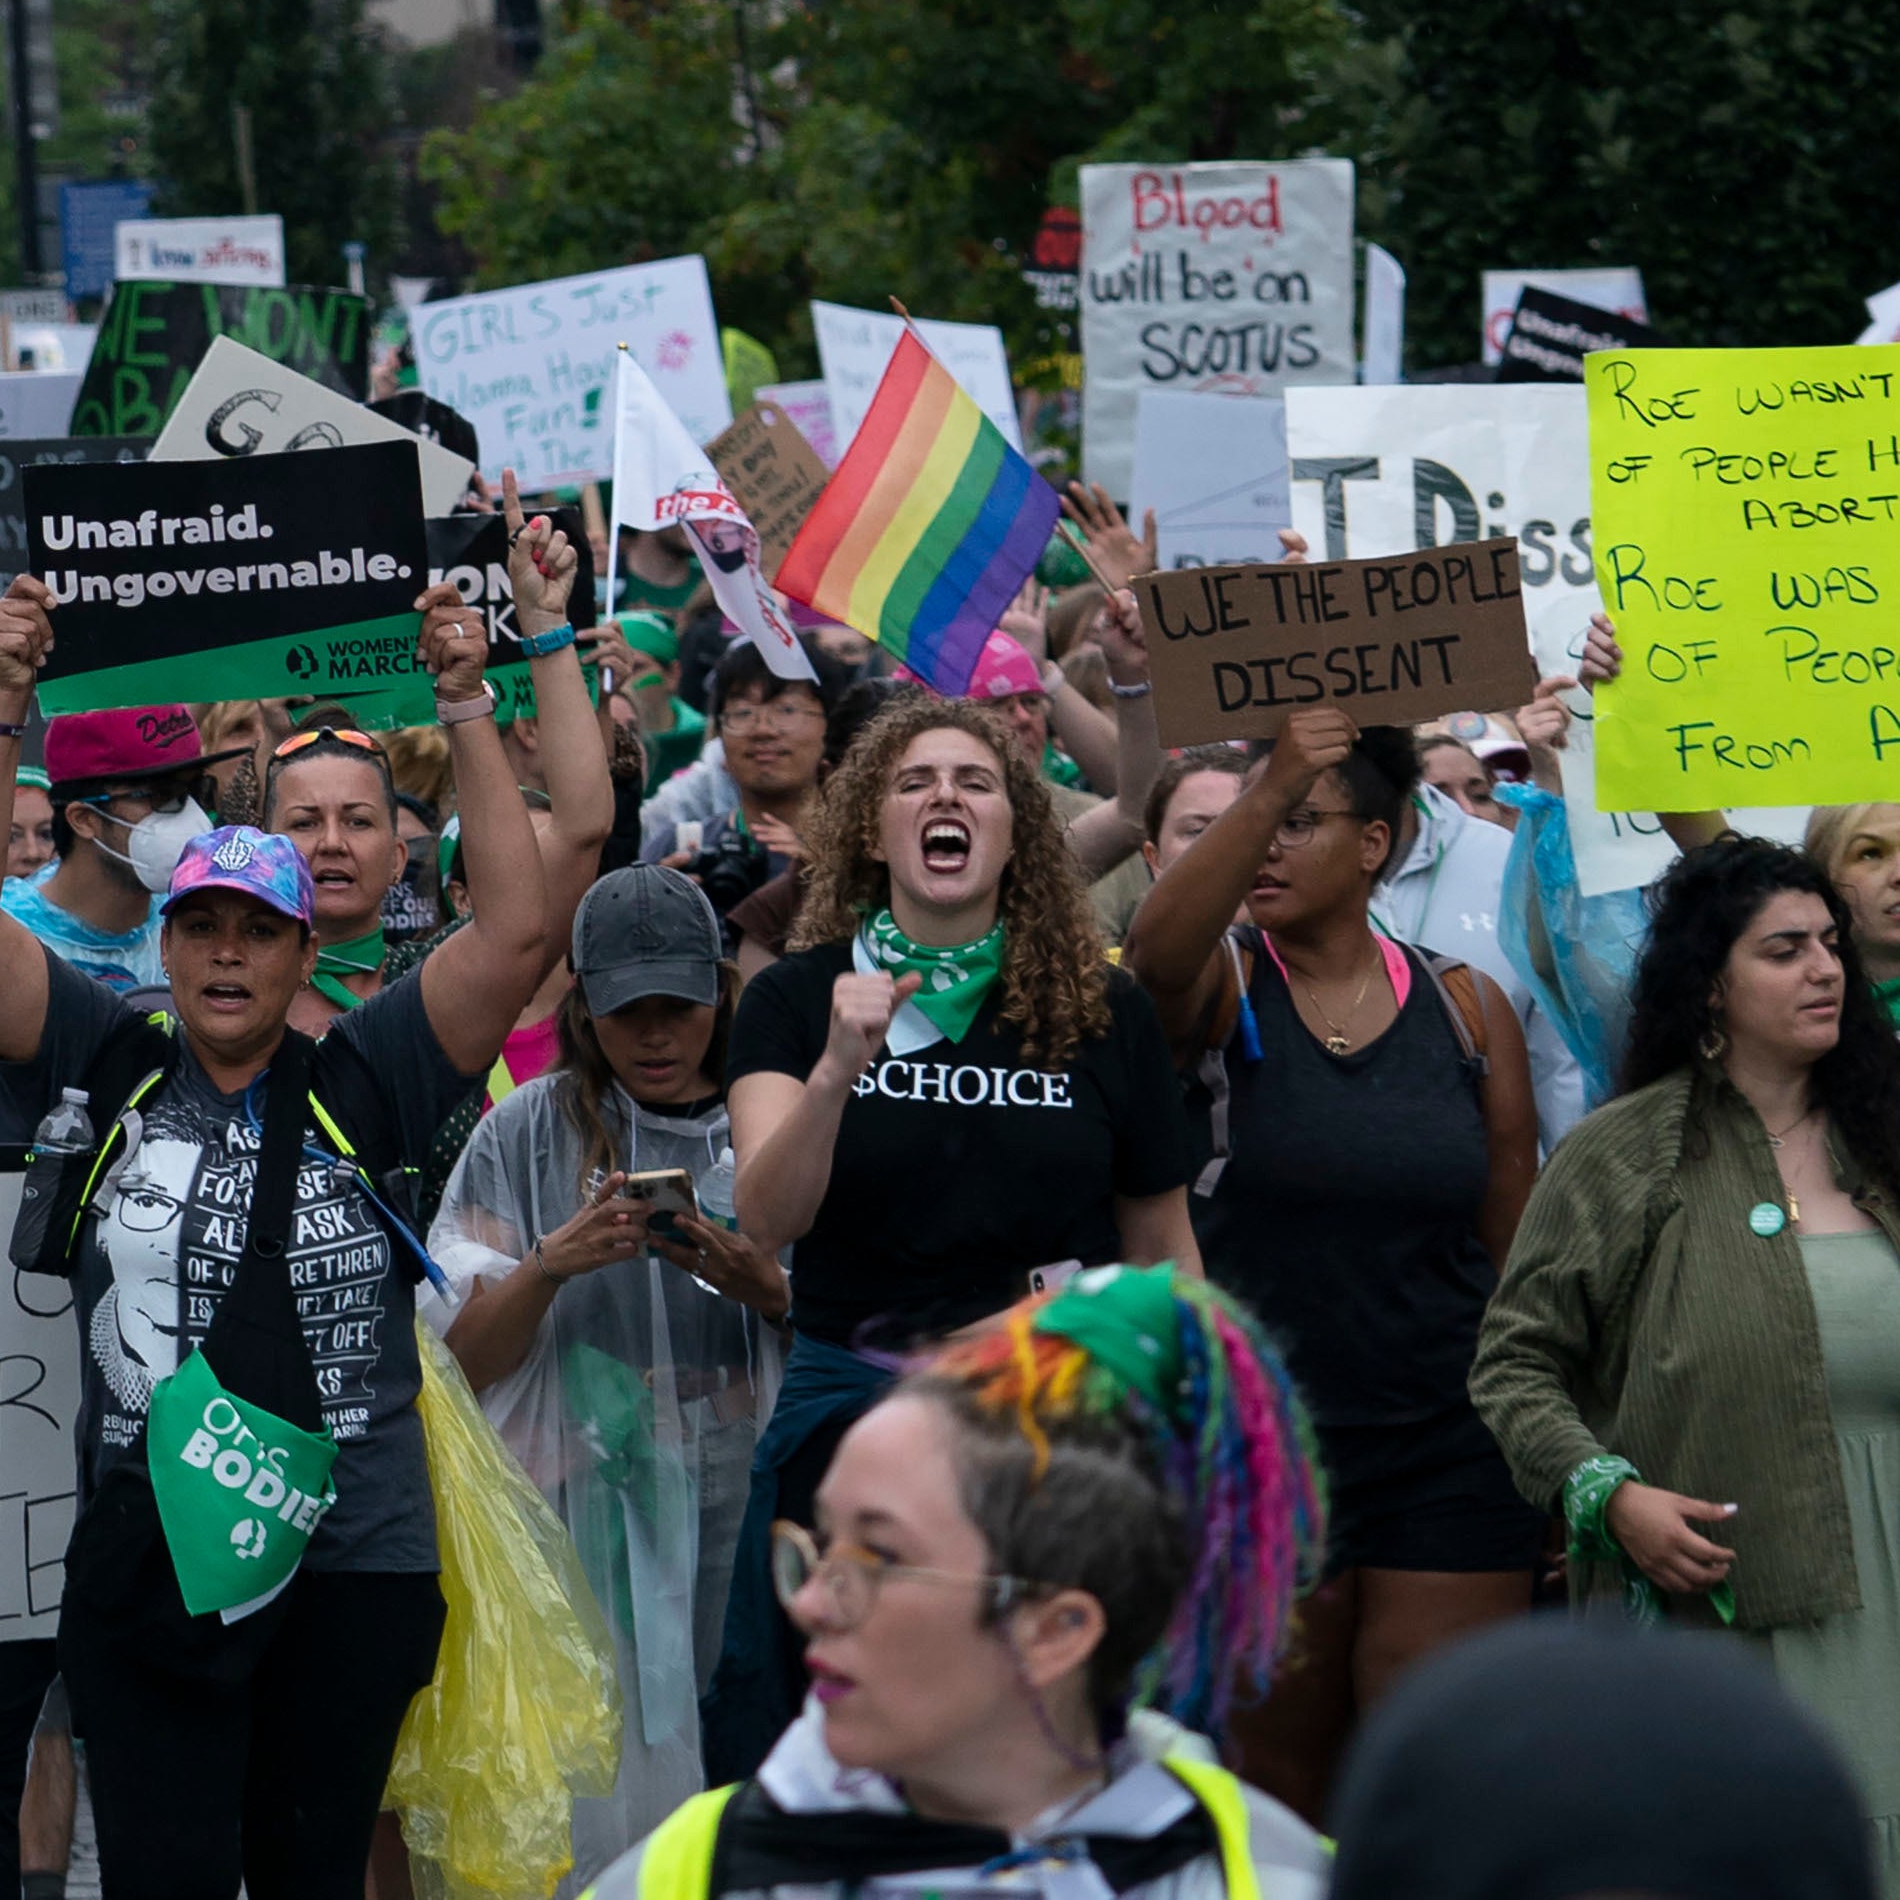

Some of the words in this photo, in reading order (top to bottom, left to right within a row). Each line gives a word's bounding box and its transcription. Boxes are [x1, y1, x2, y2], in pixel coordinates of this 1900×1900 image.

[1130, 170, 1283, 234] Blood
[1089, 250, 1165, 305] will
[1180, 250, 1237, 301] be
[1253, 271, 1310, 304] on
[421, 295, 562, 365] GIRLS
[1139, 320, 1320, 382] SCOTUS
[546, 350, 619, 393] Hav
[1602, 361, 1700, 428] ROE
[1736, 372, 1895, 415] WASN'T
[1606, 455, 1653, 485] OF
[1680, 446, 1840, 485] PEOPLE
[42, 503, 274, 552] Unafraid.
[1413, 457, 1595, 588] Diss
[1745, 494, 1900, 531] ABORT
[44, 547, 412, 607] Ungovernable.
[1149, 572, 1249, 643] WE
[1257, 567, 1351, 626] THE
[1363, 548, 1522, 619] PEOPLE
[1606, 543, 1723, 613] ROE
[1771, 565, 1880, 612] WAS
[1213, 634, 1461, 714] DISSENT
[1647, 639, 1719, 683] OF
[1764, 625, 1900, 684] PEOP
[1667, 720, 1811, 772] FROM
[296, 1204, 356, 1246] ASK
[186, 1256, 216, 1284] OF
[289, 1241, 383, 1287] RETHREN
[188, 1296, 211, 1319] IS
[332, 1284, 374, 1311] TAKE
[332, 1320, 371, 1351] OFF
